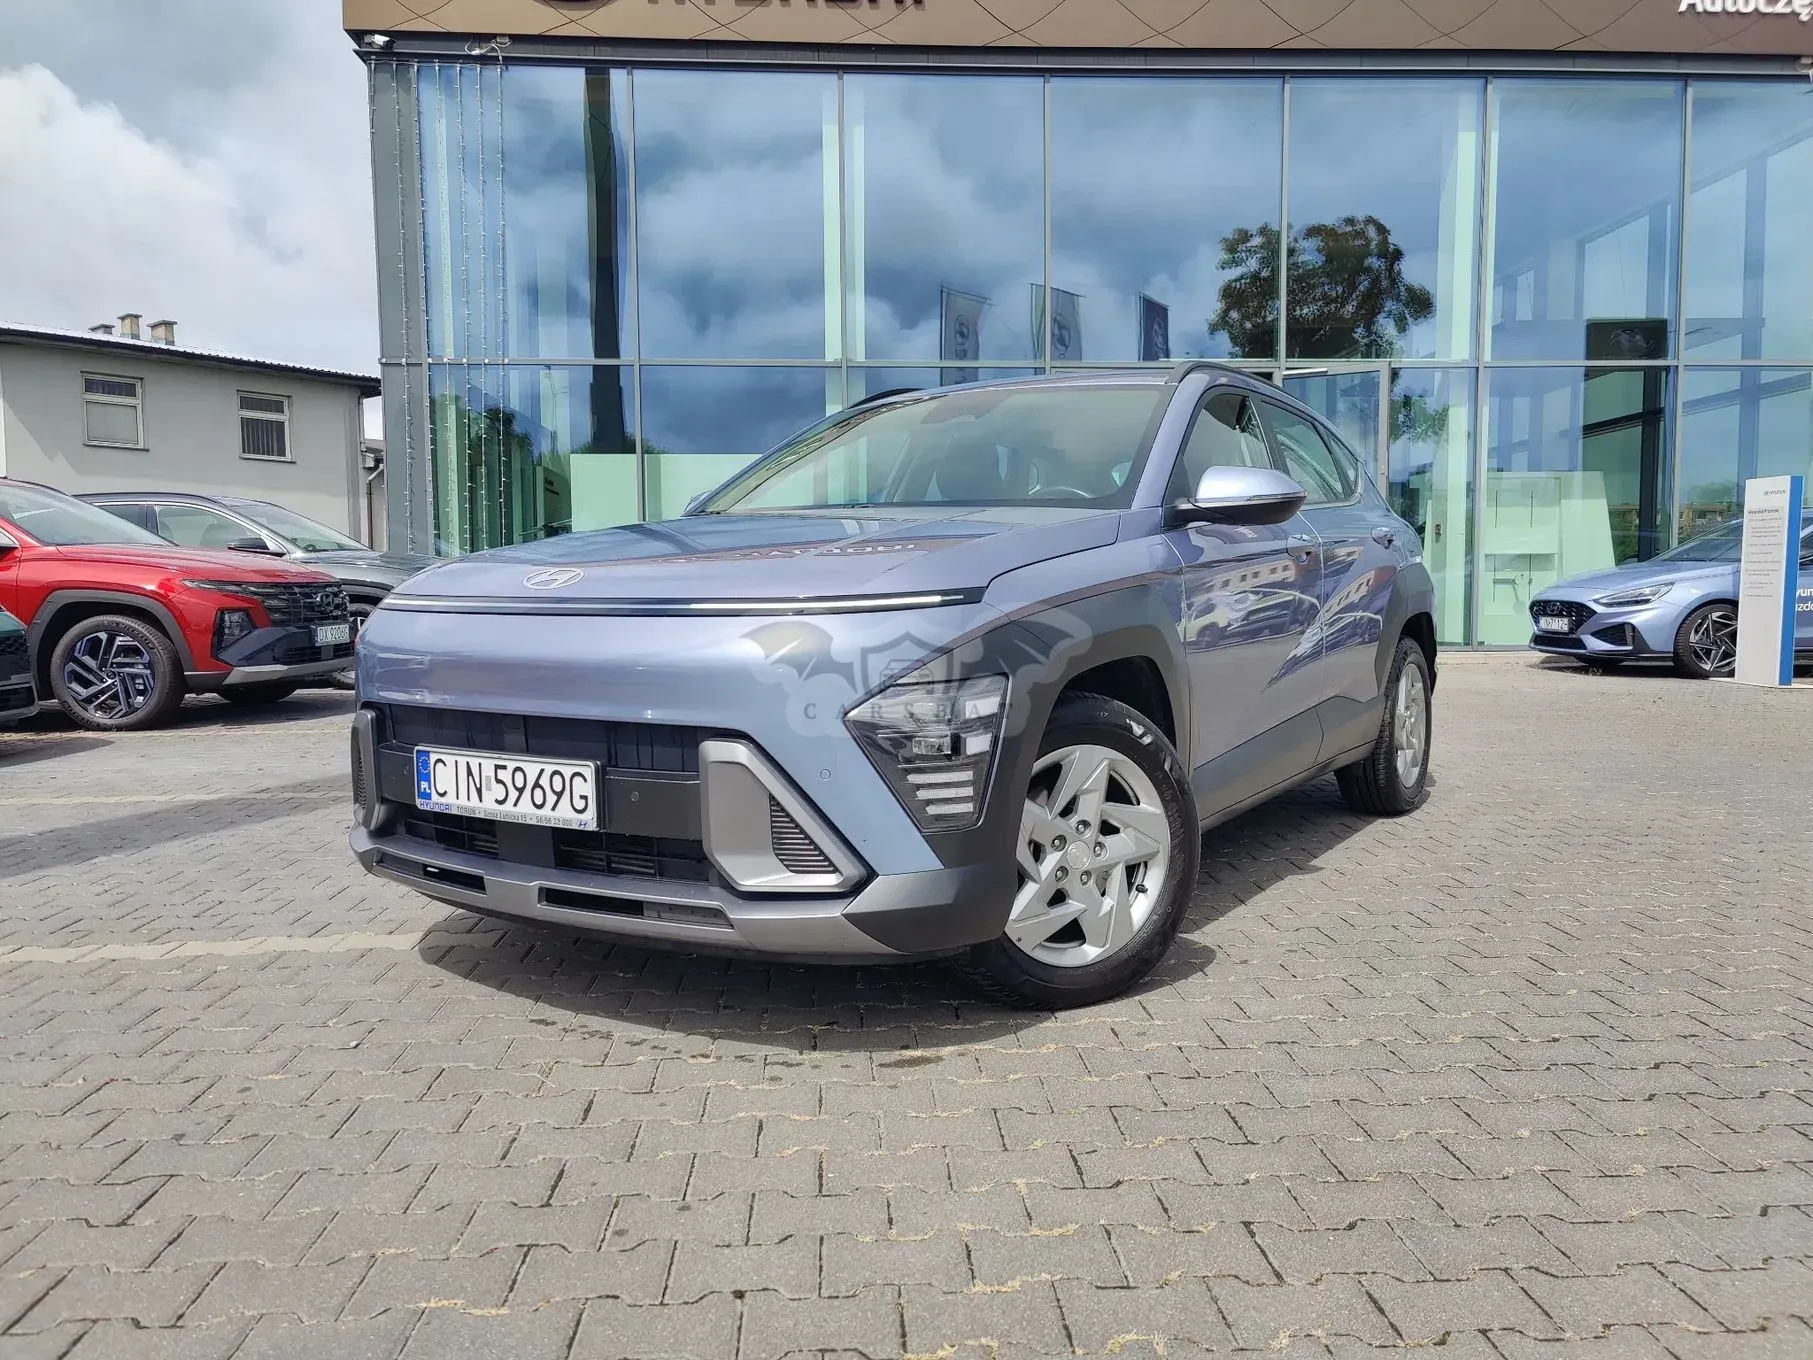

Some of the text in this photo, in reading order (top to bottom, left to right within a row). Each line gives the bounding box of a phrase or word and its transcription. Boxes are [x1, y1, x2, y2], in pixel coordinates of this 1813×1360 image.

[421, 781, 431, 793] PL
[433, 758, 588, 814] CIN 5969G
